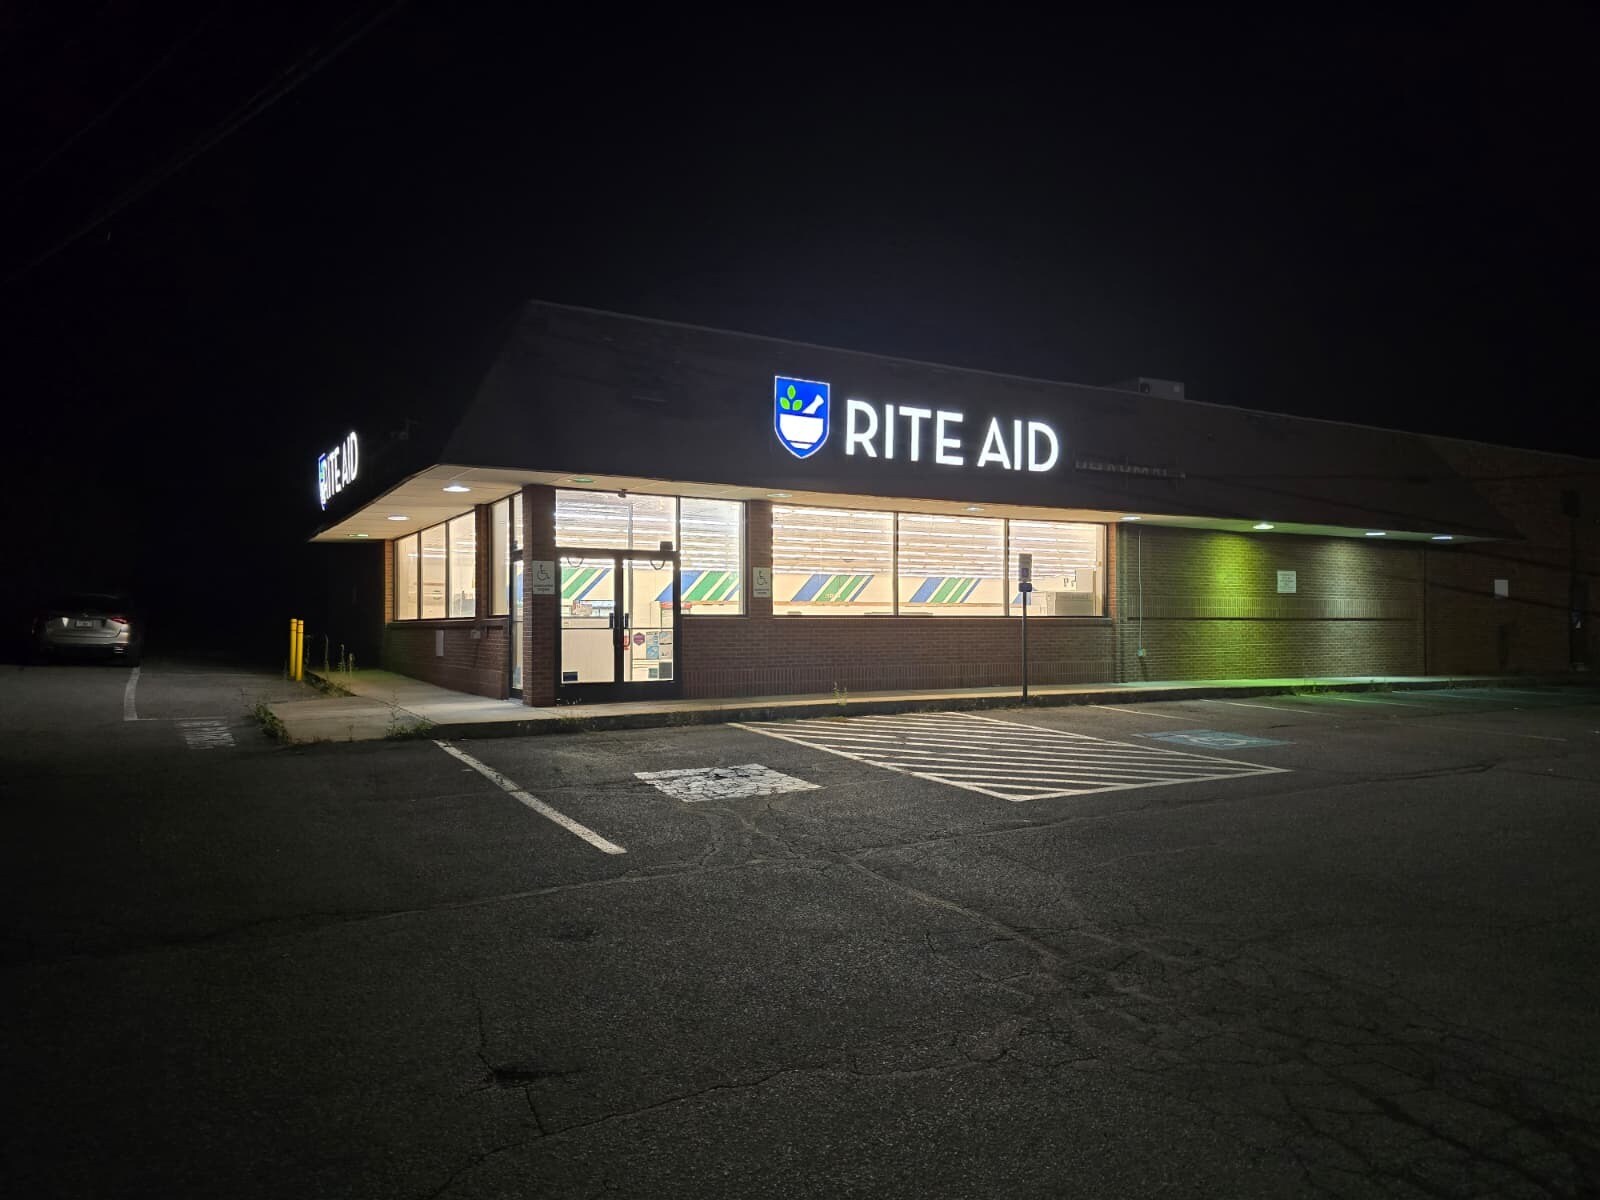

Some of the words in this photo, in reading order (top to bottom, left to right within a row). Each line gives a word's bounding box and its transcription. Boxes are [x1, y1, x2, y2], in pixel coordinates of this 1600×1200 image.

[342, 431, 359, 487] AID
[845, 399, 964, 466] RITE
[976, 417, 1060, 472] AID
